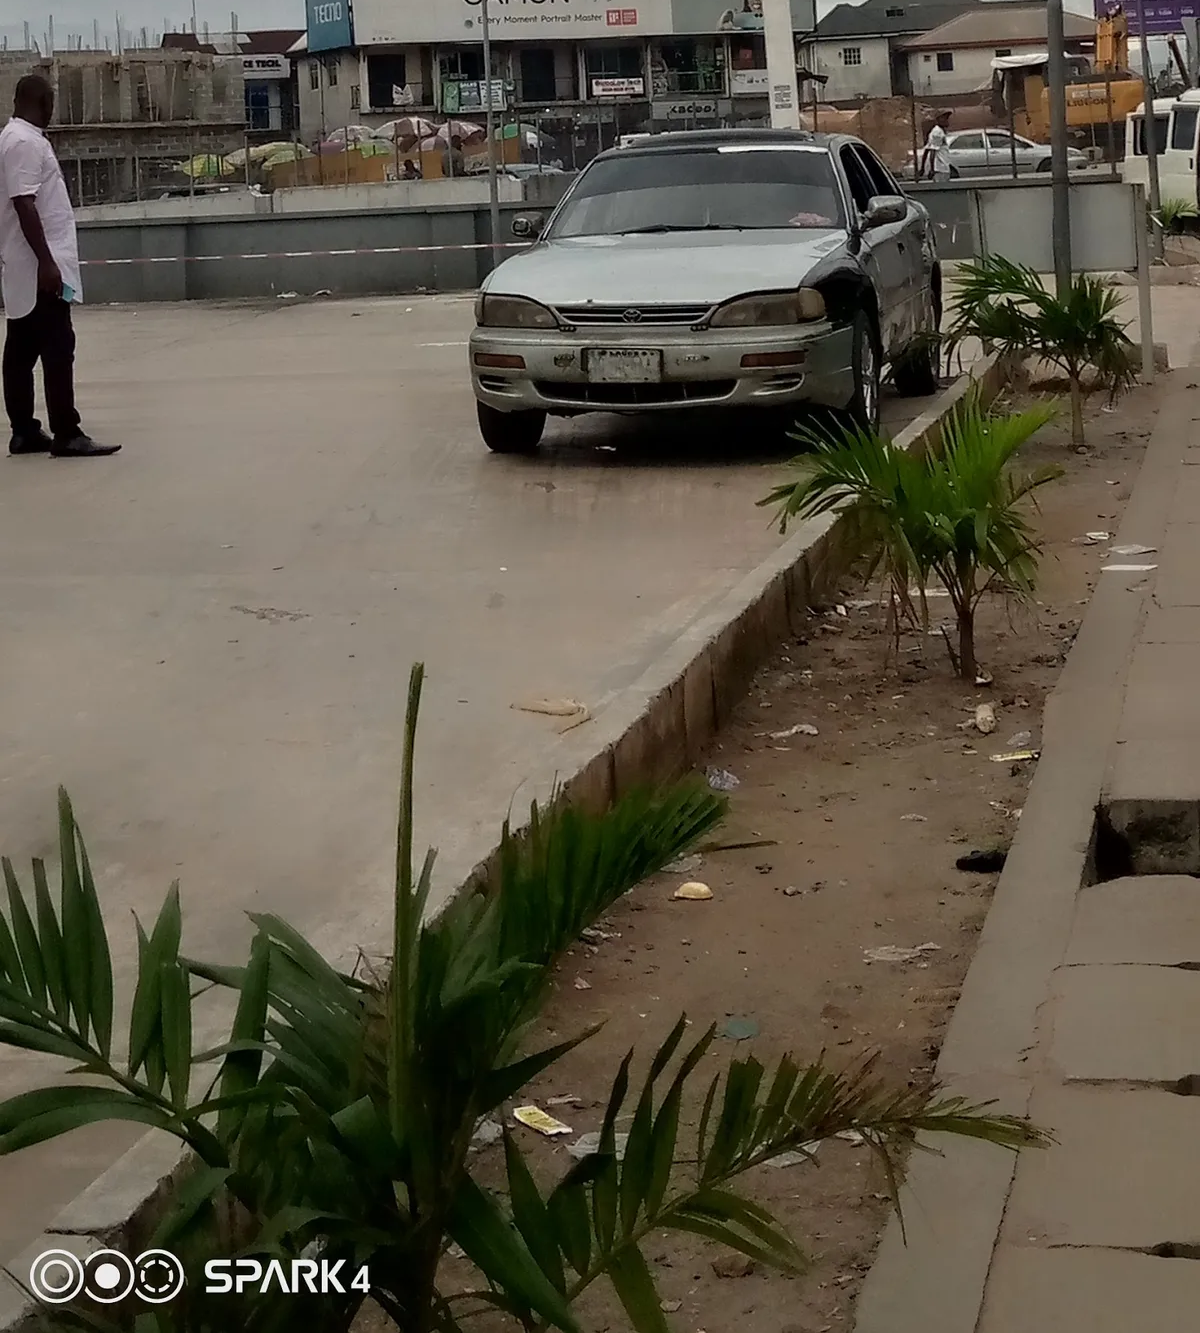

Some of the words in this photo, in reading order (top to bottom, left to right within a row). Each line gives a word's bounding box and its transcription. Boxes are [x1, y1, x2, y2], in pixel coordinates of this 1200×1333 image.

[313, 2, 343, 24] TECNO
[477, 16, 500, 26] Eery
[503, 14, 538, 24] Moment
[540, 13, 572, 23] Portrait
[574, 13, 603, 22] Master
